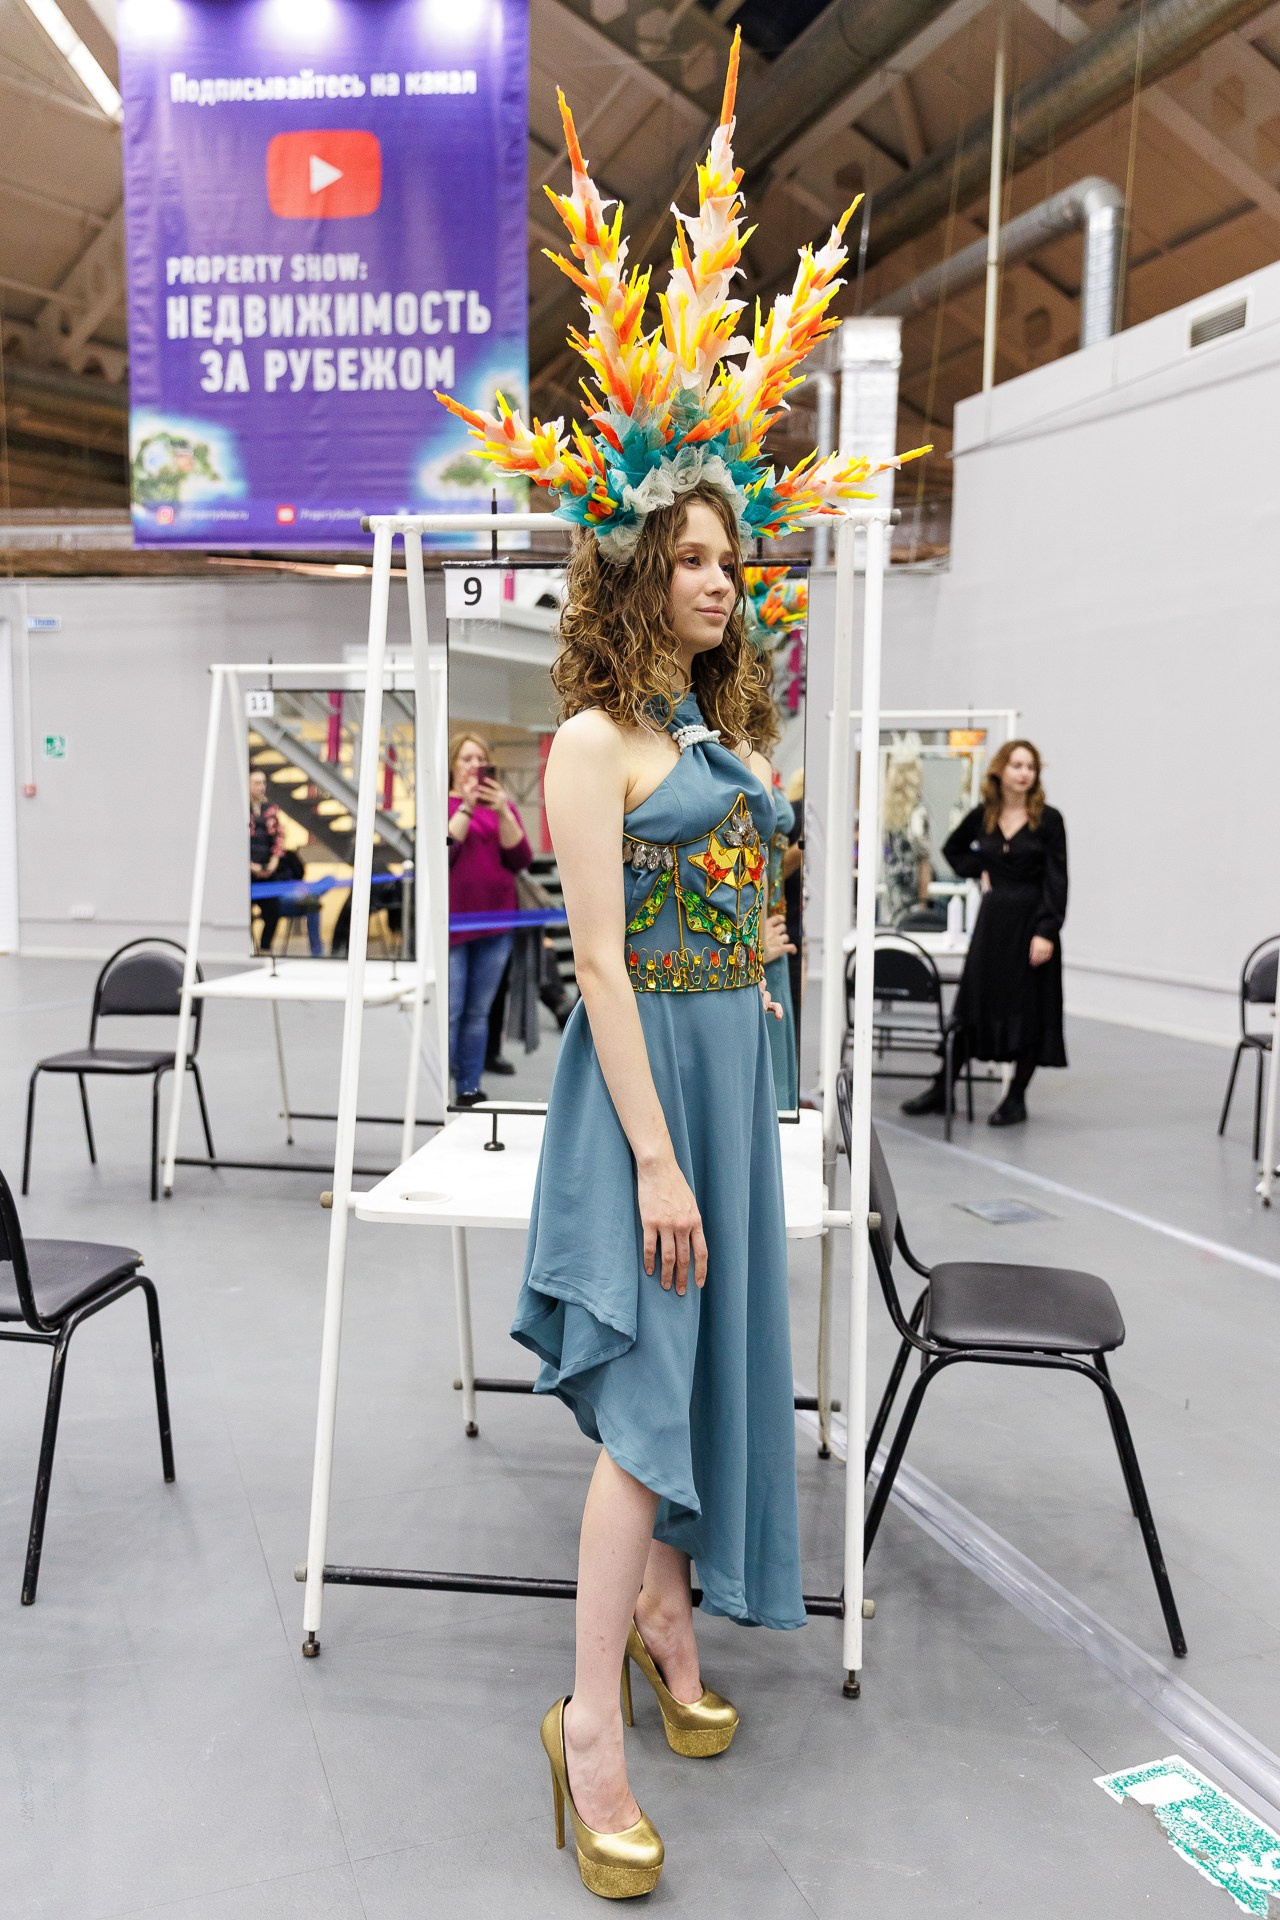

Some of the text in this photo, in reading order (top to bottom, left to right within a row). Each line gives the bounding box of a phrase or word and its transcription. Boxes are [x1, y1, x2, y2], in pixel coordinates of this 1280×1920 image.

[170, 69, 477, 106] Подписывайтесь на канал
[166, 252, 368, 285] PROPERTY SHOW:
[166, 289, 492, 345] НЕДВИЖИМОСТЬ
[200, 345, 455, 393] ЗА РУБЕЖОМ
[464, 577, 482, 606] 9
[251, 696, 267, 710] 11
